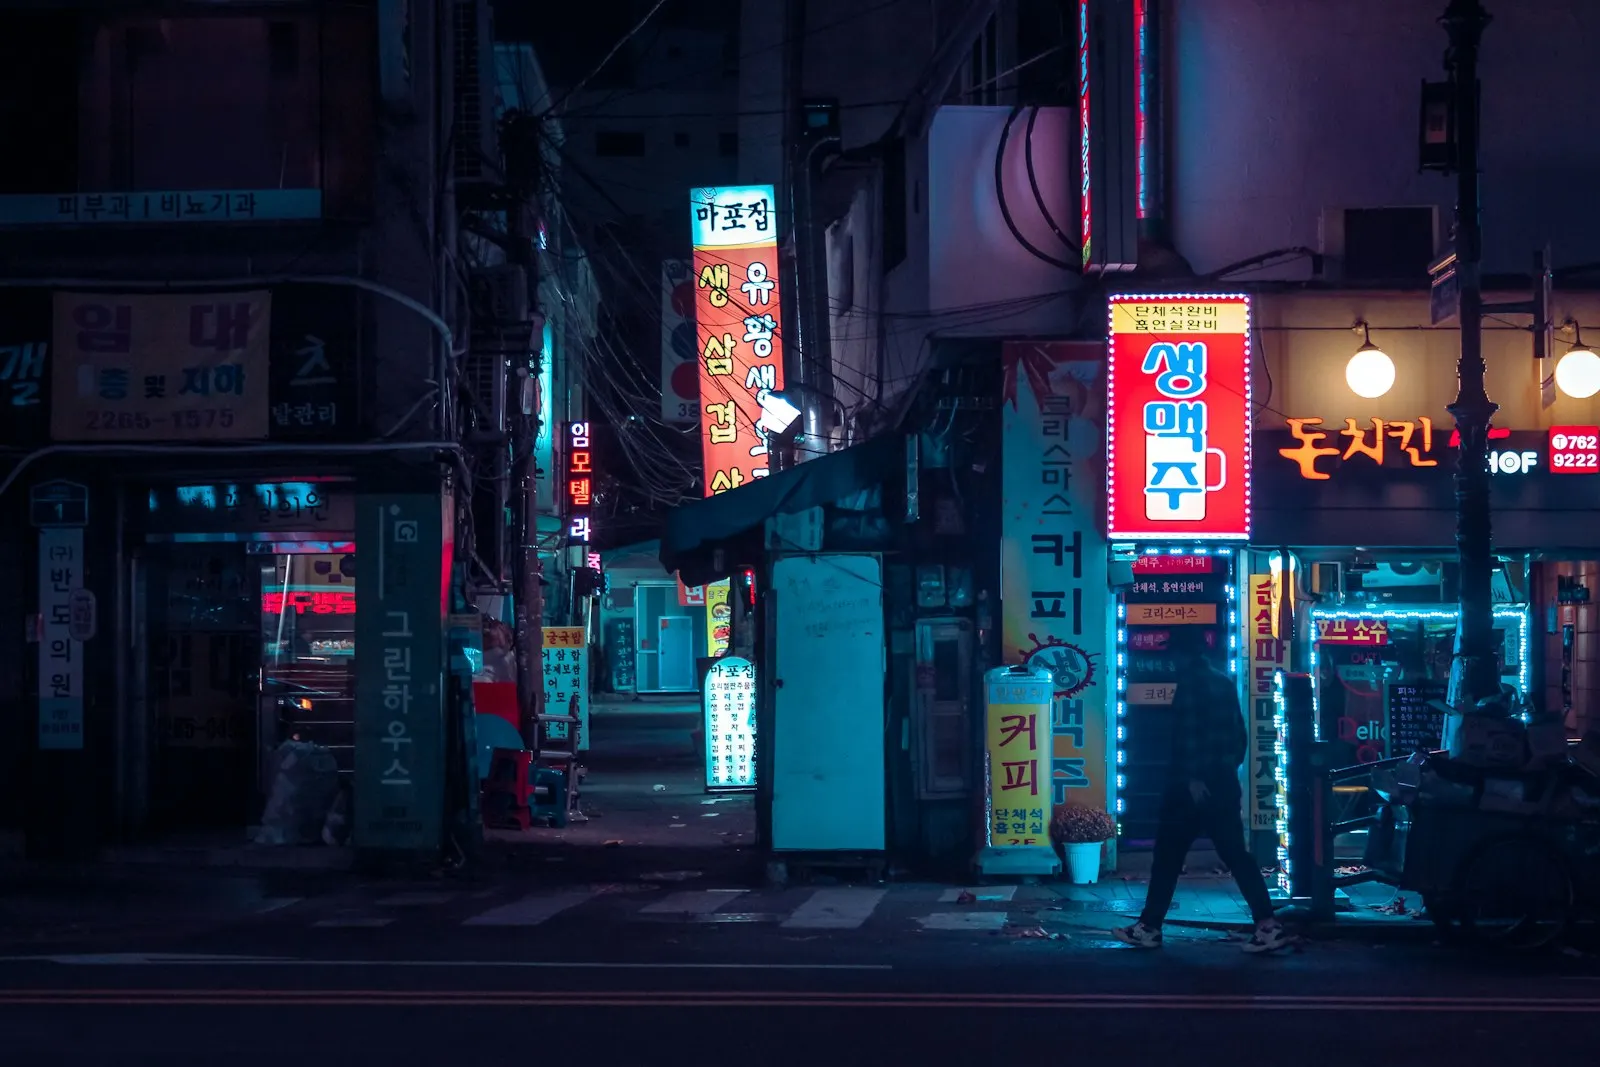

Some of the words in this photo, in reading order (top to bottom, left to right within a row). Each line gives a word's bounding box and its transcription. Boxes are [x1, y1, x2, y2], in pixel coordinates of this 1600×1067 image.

[57, 194, 134, 220] 피부과
[161, 192, 257, 218] 비뇨기과
[696, 198, 768, 232] 마포집
[1135, 305, 1218, 317] 단체석완비
[178, 363, 246, 397] 지하
[1141, 341, 1208, 511] 생맥주
[1040, 394, 1074, 516] 크리스마스
[1278, 416, 1439, 480] 돈치킨
[1553, 453, 1597, 468] 9222
[1184, 556, 1205, 568] 커피
[1030, 530, 1083, 637] 커피
[1141, 606, 1198, 619] 크리스마스
[50, 567, 73, 698] 반도의원
[709, 664, 755, 679] 마포집
[380, 611, 413, 785] 그린하우스
[711, 744, 746, 754] 김치찌
[998, 713, 1038, 796] 커피
[994, 821, 1044, 835] 흡연실
[995, 807, 1044, 821] 단체석
